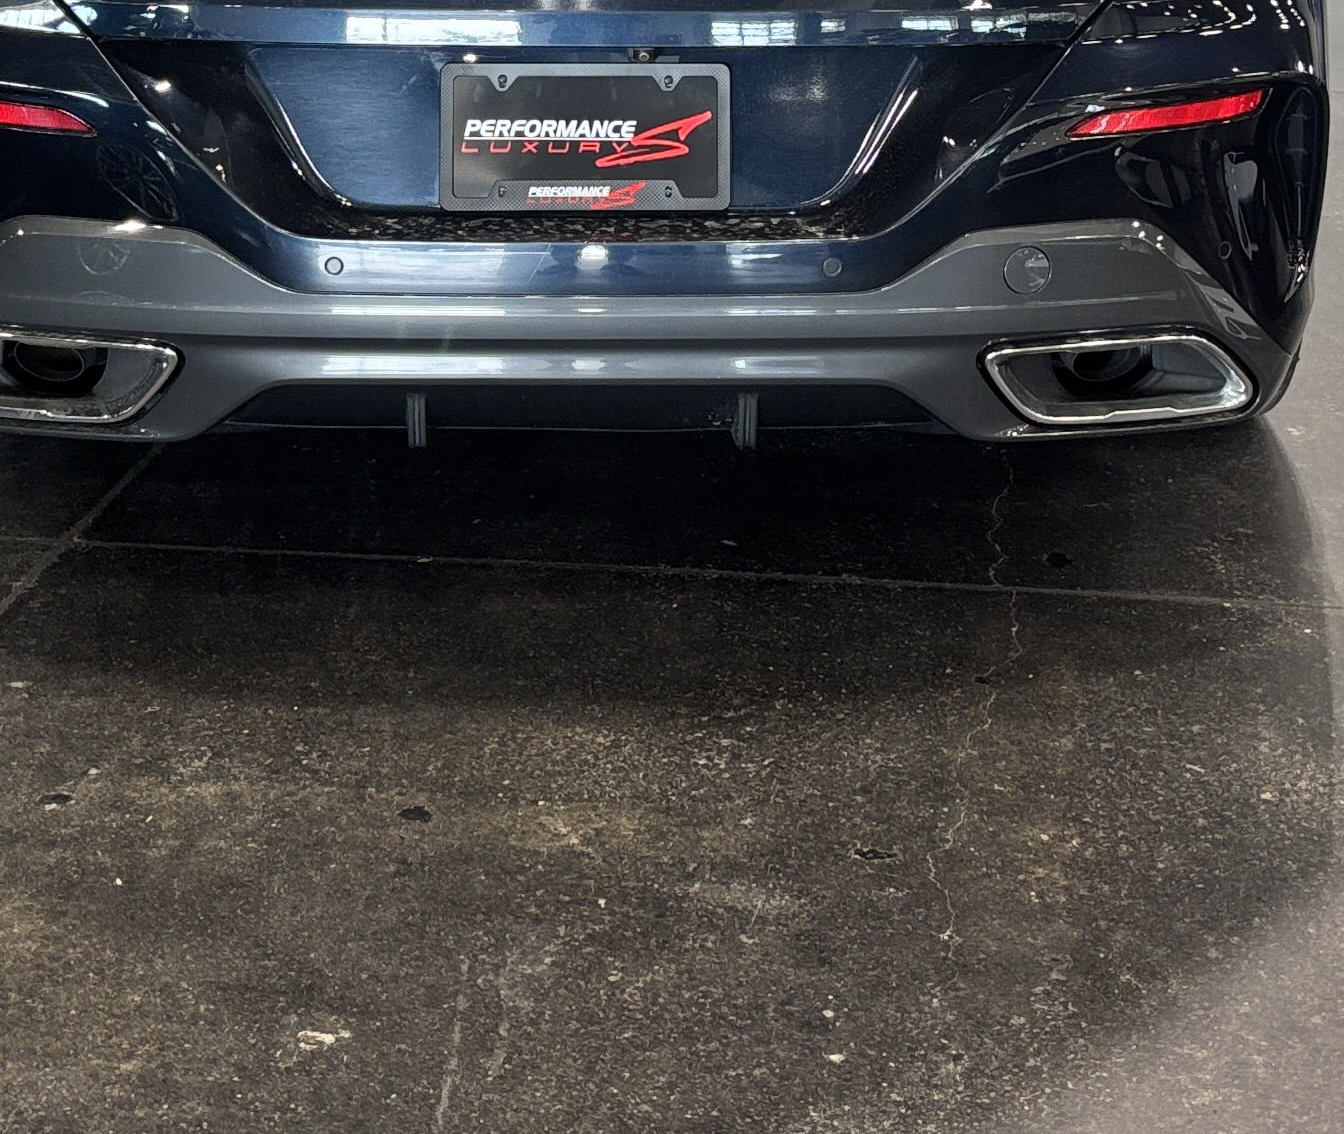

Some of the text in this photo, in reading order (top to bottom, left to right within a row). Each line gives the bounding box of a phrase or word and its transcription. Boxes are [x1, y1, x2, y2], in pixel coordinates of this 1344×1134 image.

[463, 119, 638, 139] PERFORMANCE
[461, 140, 632, 154] LUXURY
[528, 186, 611, 197] PERFORMANCE
